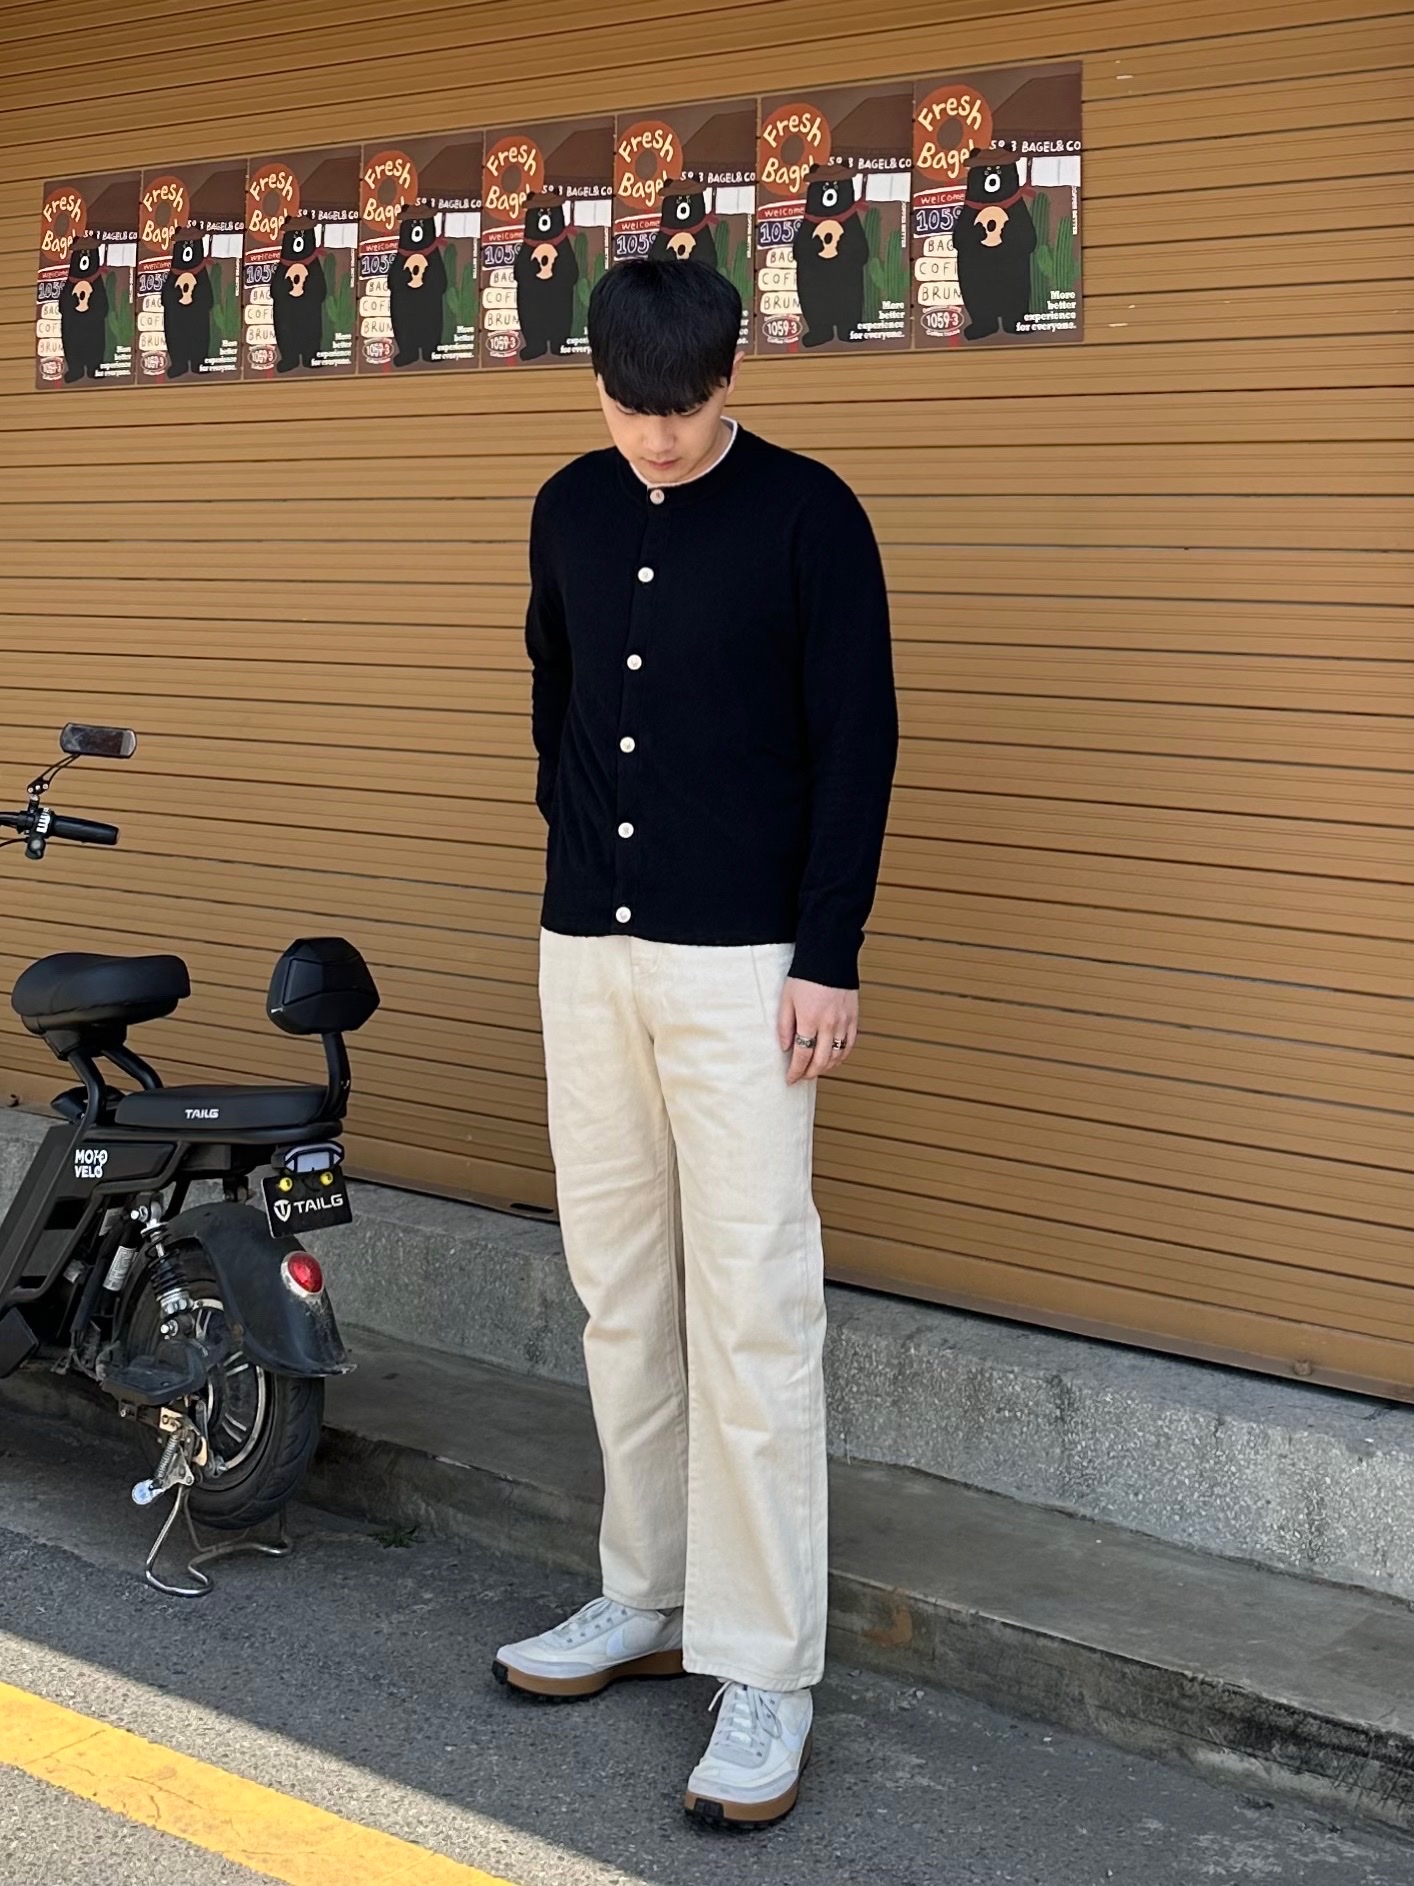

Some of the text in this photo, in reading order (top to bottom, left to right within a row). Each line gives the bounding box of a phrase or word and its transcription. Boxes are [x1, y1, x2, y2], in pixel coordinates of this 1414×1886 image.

[917, 95, 982, 132] Fresh
[763, 112, 821, 148] Fresh
[618, 129, 674, 163] Fresh
[486, 144, 536, 176] Fresh
[364, 158, 410, 190] Fresh
[249, 171, 293, 201] Fresh
[143, 183, 184, 212] Fresh
[43, 195, 81, 222] Fresh
[1050, 290, 1076, 300] More
[1047, 300, 1076, 310] better
[926, 312, 959, 328] 1059-3
[1024, 311, 1076, 323] experience
[767, 320, 797, 336] 1059-3
[849, 331, 863, 340] for
[1016, 322, 1030, 332] for
[185, 1108, 219, 1119] TAILG
[74, 1165, 103, 1178] VELO
[293, 1193, 343, 1214] TAILG
